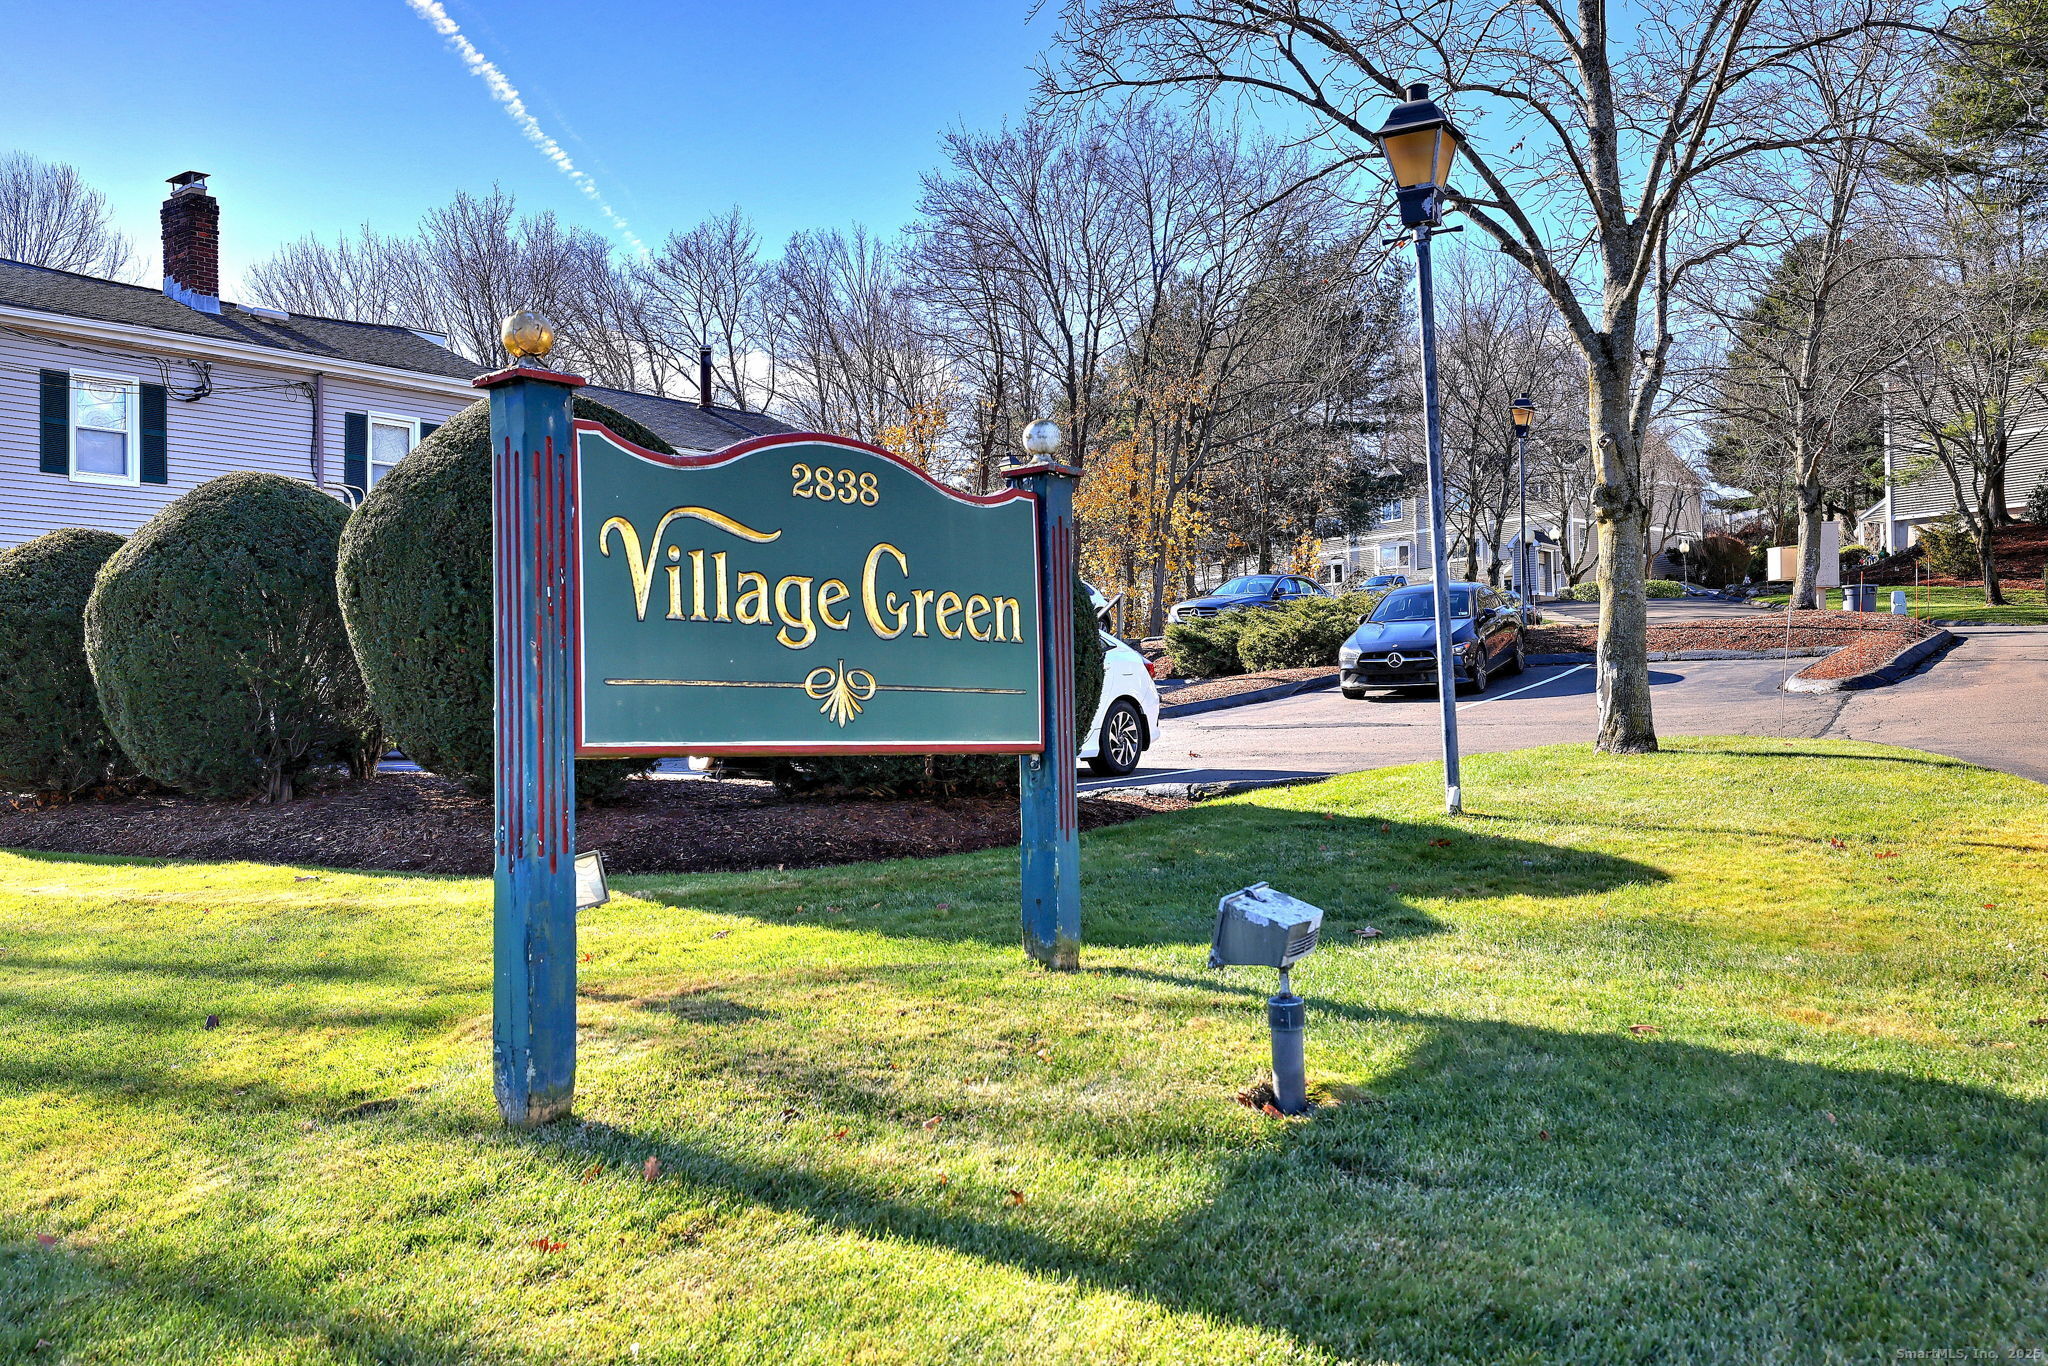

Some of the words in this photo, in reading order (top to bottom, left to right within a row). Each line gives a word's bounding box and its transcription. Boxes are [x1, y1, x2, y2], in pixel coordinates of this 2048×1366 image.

[791, 462, 880, 507] 2838
[599, 505, 852, 650] Village
[862, 542, 1024, 644] Green
